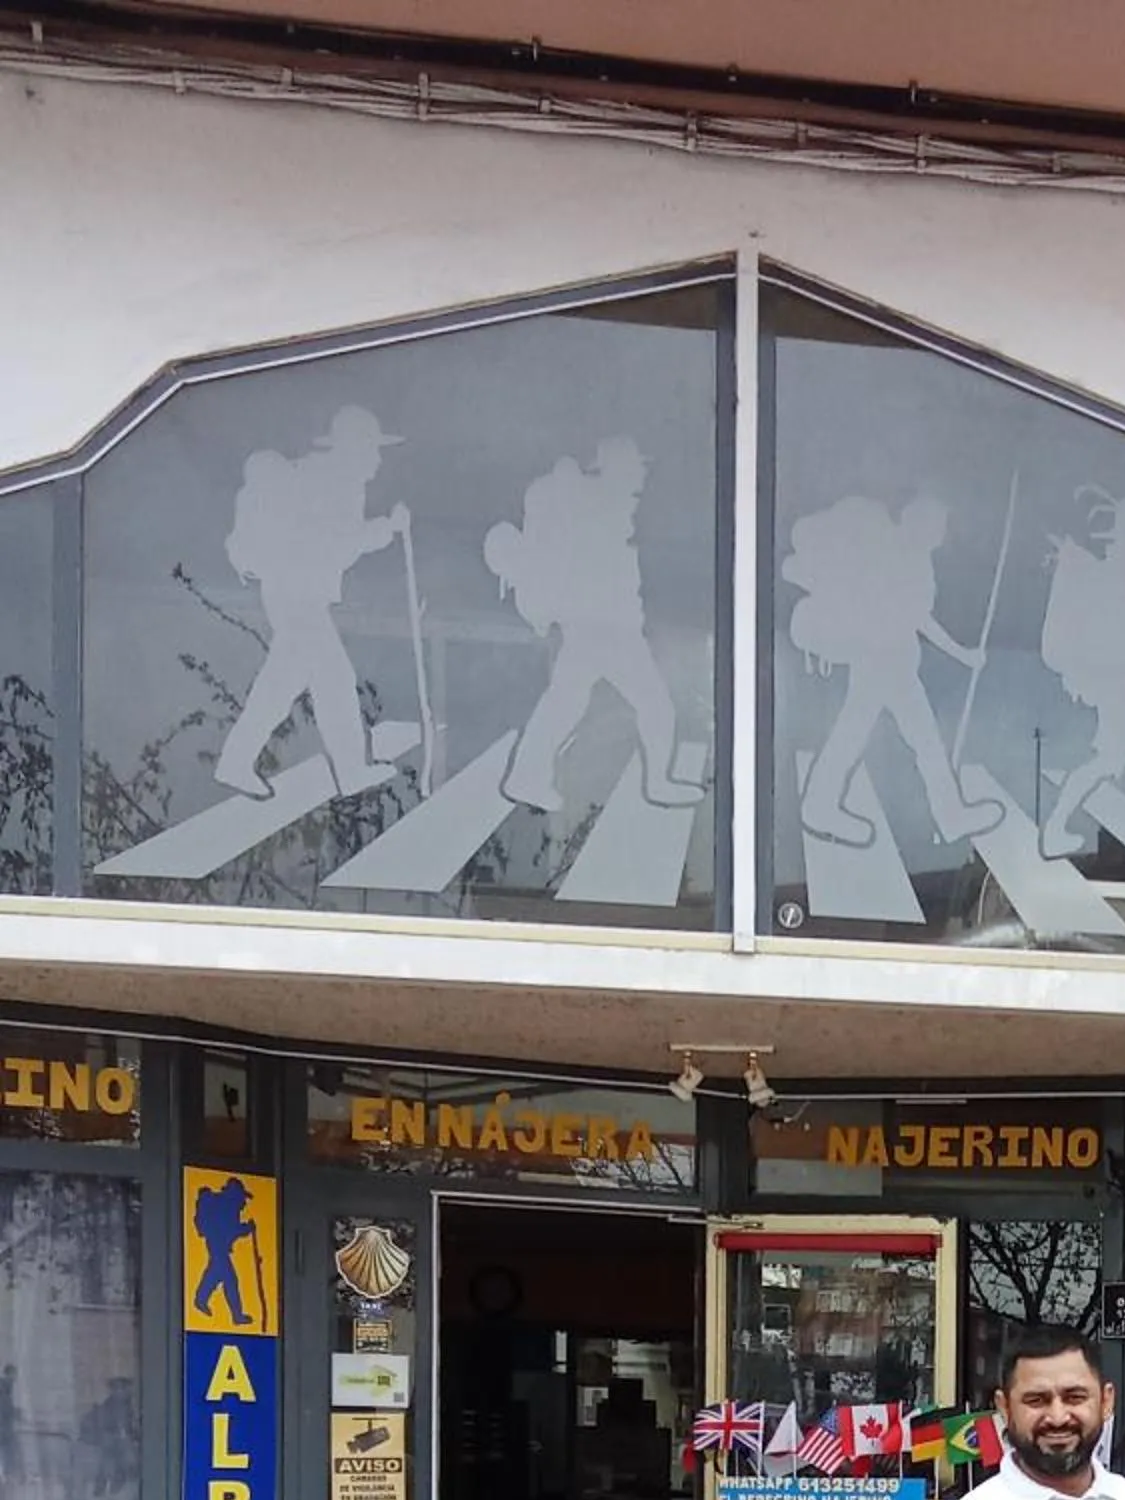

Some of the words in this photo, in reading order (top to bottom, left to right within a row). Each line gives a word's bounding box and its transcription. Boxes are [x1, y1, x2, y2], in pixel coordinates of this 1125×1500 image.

[0, 1057, 135, 1115] INO
[352, 1096, 426, 1146] EN
[438, 1090, 657, 1161] NÁJERA
[827, 1125, 1099, 1168] NAJERINO
[339, 1459, 400, 1473] AVISO
